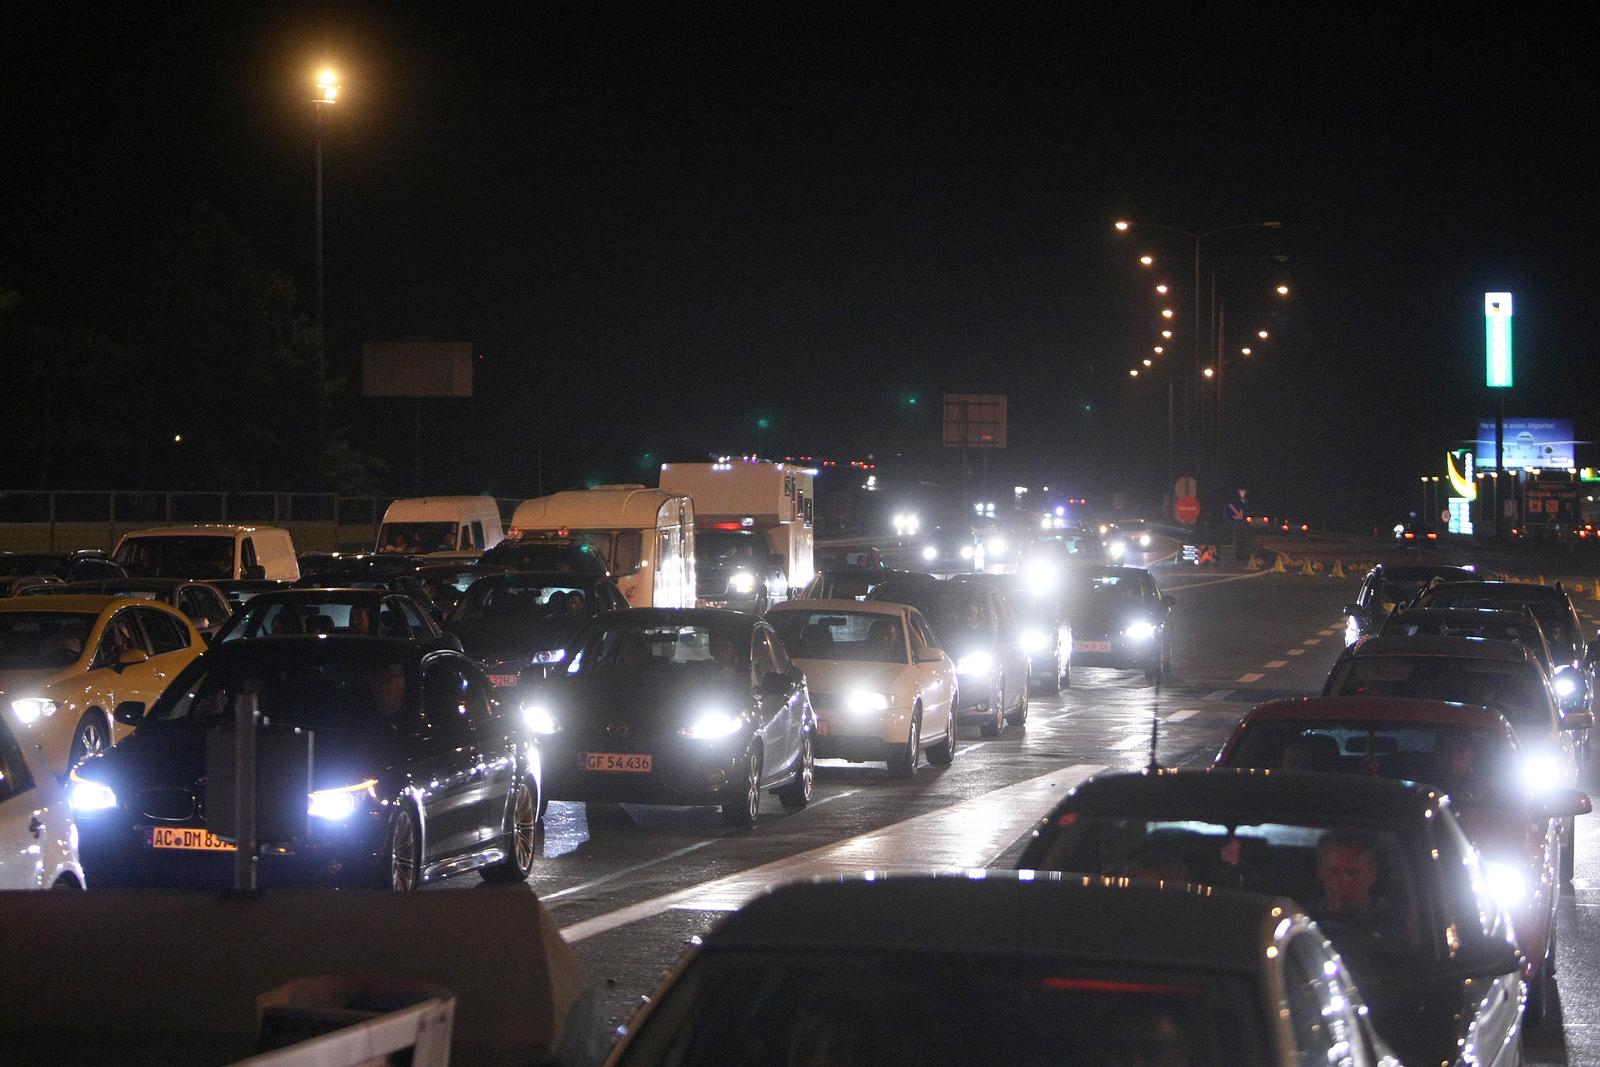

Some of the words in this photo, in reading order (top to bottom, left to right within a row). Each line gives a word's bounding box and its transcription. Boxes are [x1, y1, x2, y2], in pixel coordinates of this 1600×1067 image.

[587, 756, 604, 768] GF
[154, 830, 173, 846] AC
[183, 831, 202, 847] DM
